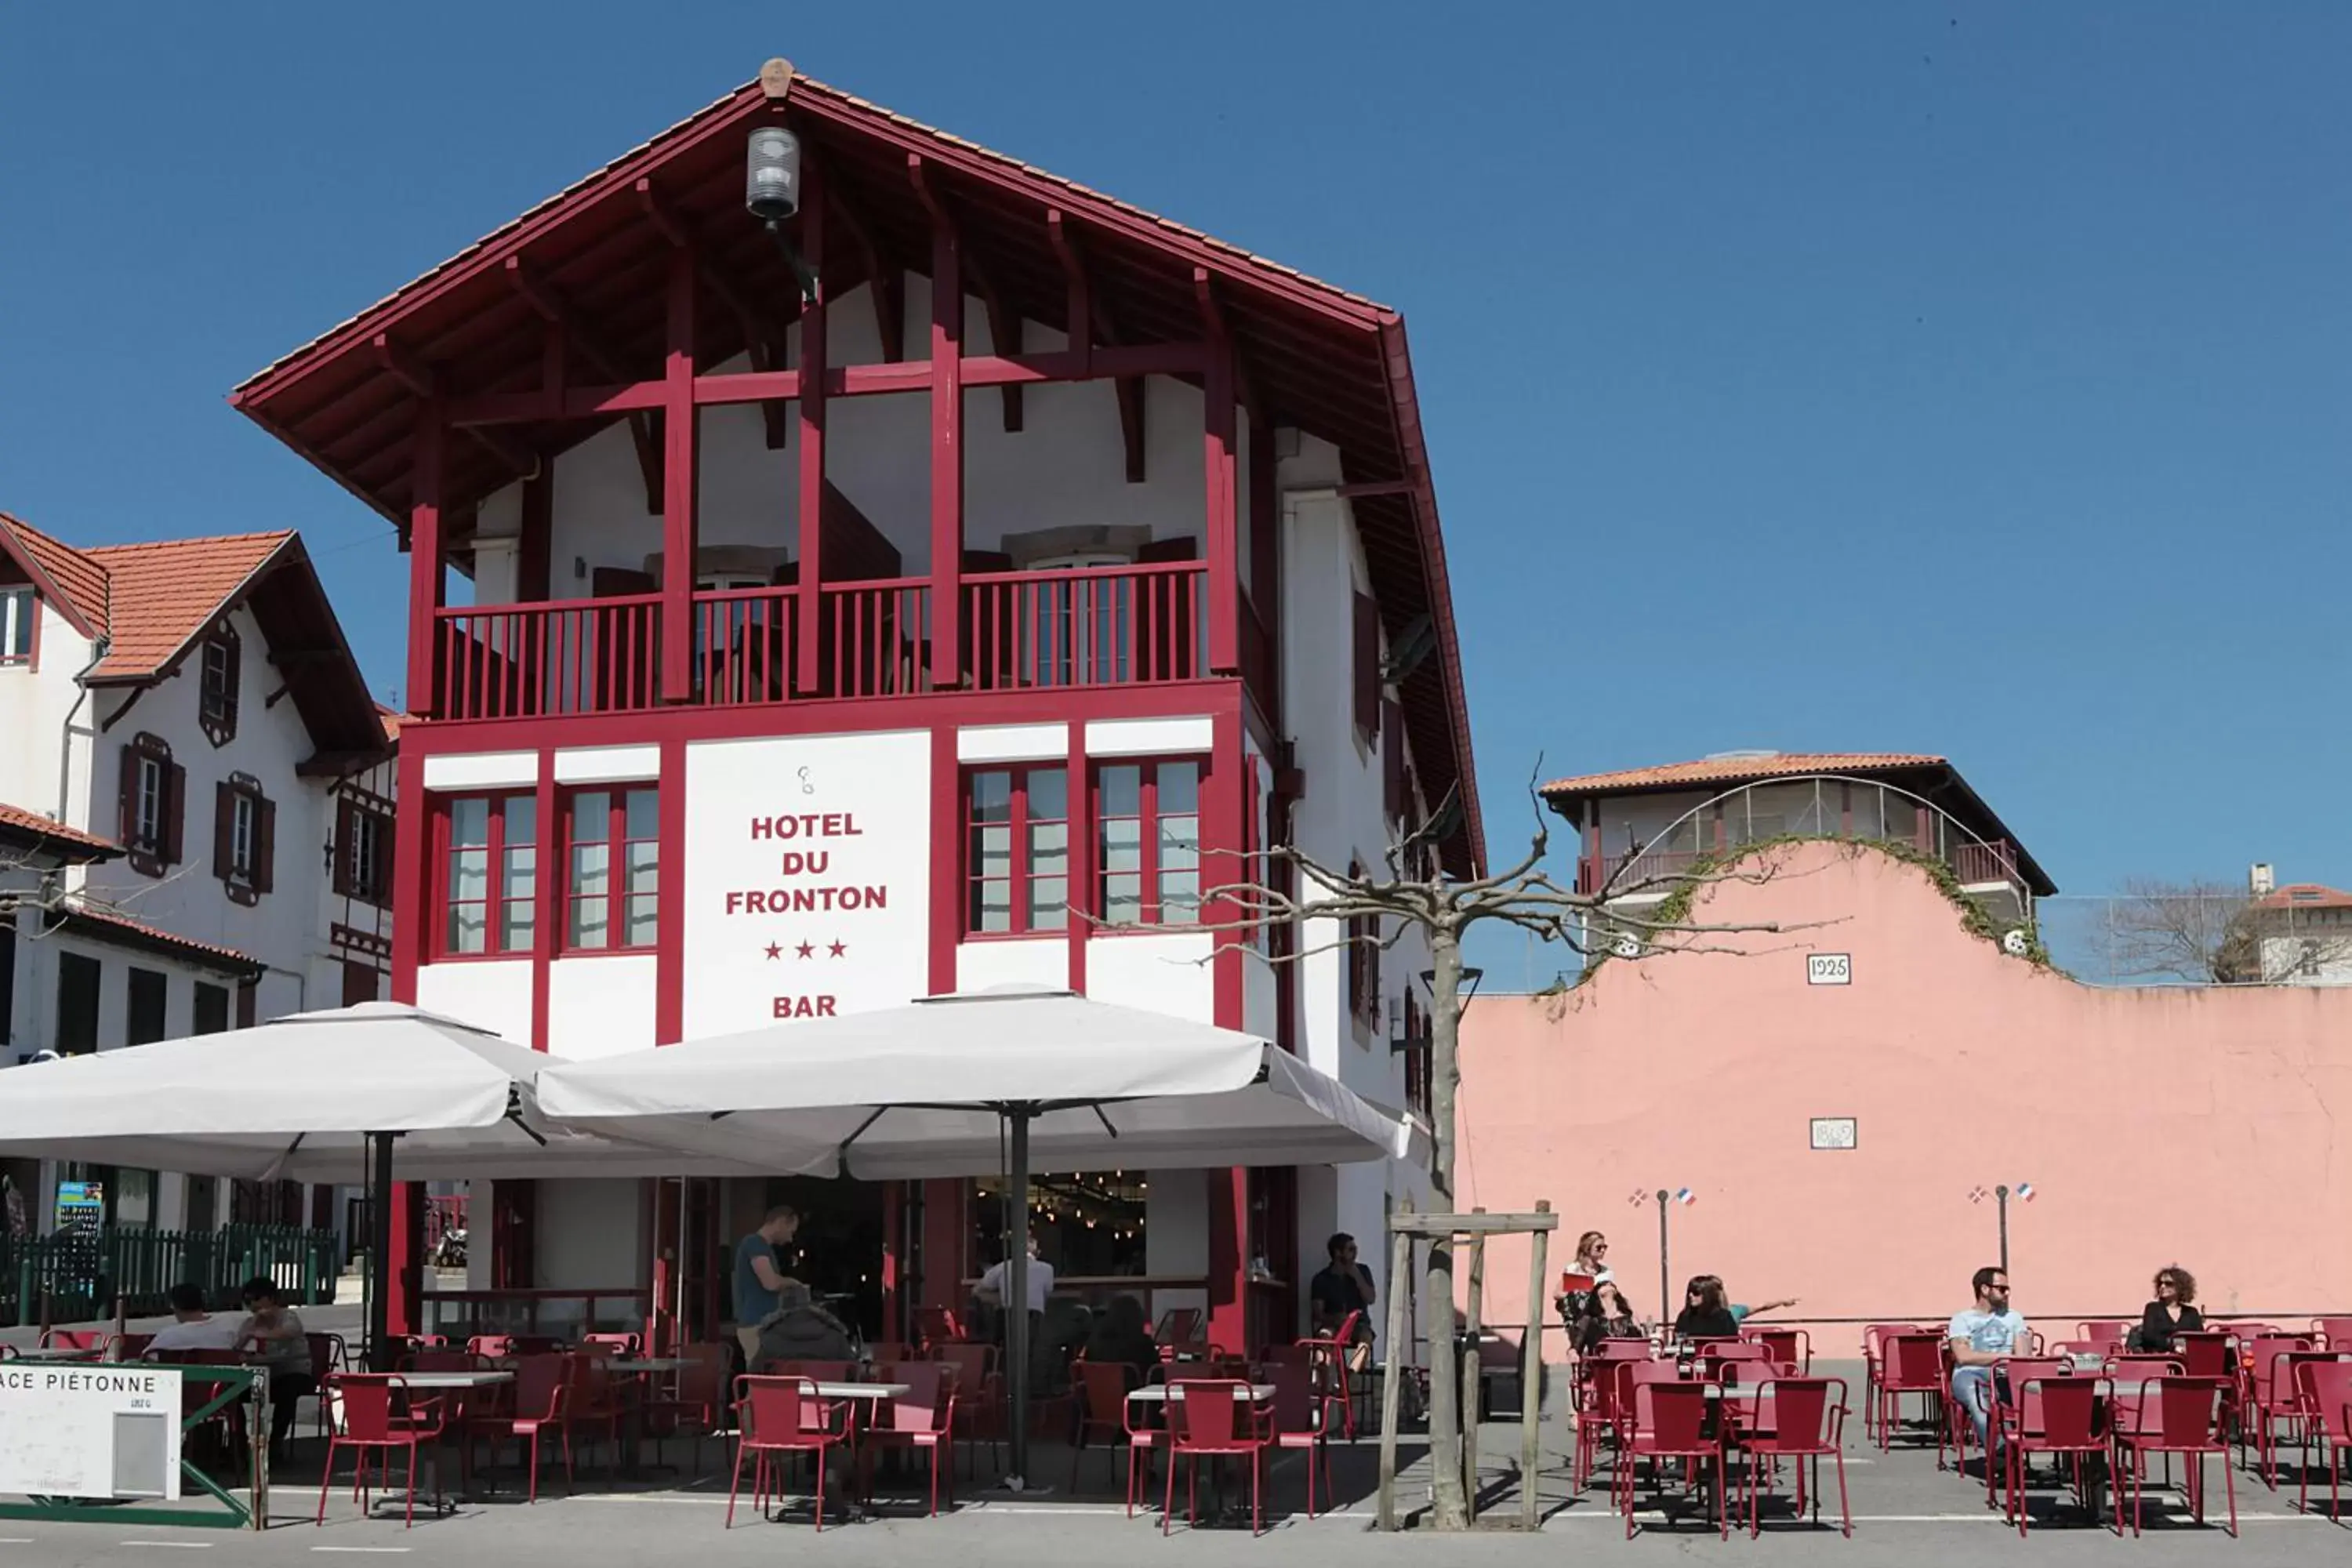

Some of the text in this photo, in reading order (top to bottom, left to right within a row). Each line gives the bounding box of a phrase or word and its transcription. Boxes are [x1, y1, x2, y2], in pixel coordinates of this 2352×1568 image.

[751, 813, 862, 840] HOTEL
[782, 851, 829, 876] DU
[726, 886, 887, 915] FRONTON
[1812, 959, 1846, 976] 1925
[773, 996, 837, 1018] BAR
[46, 1372, 156, 1392] PIÉTONNE
